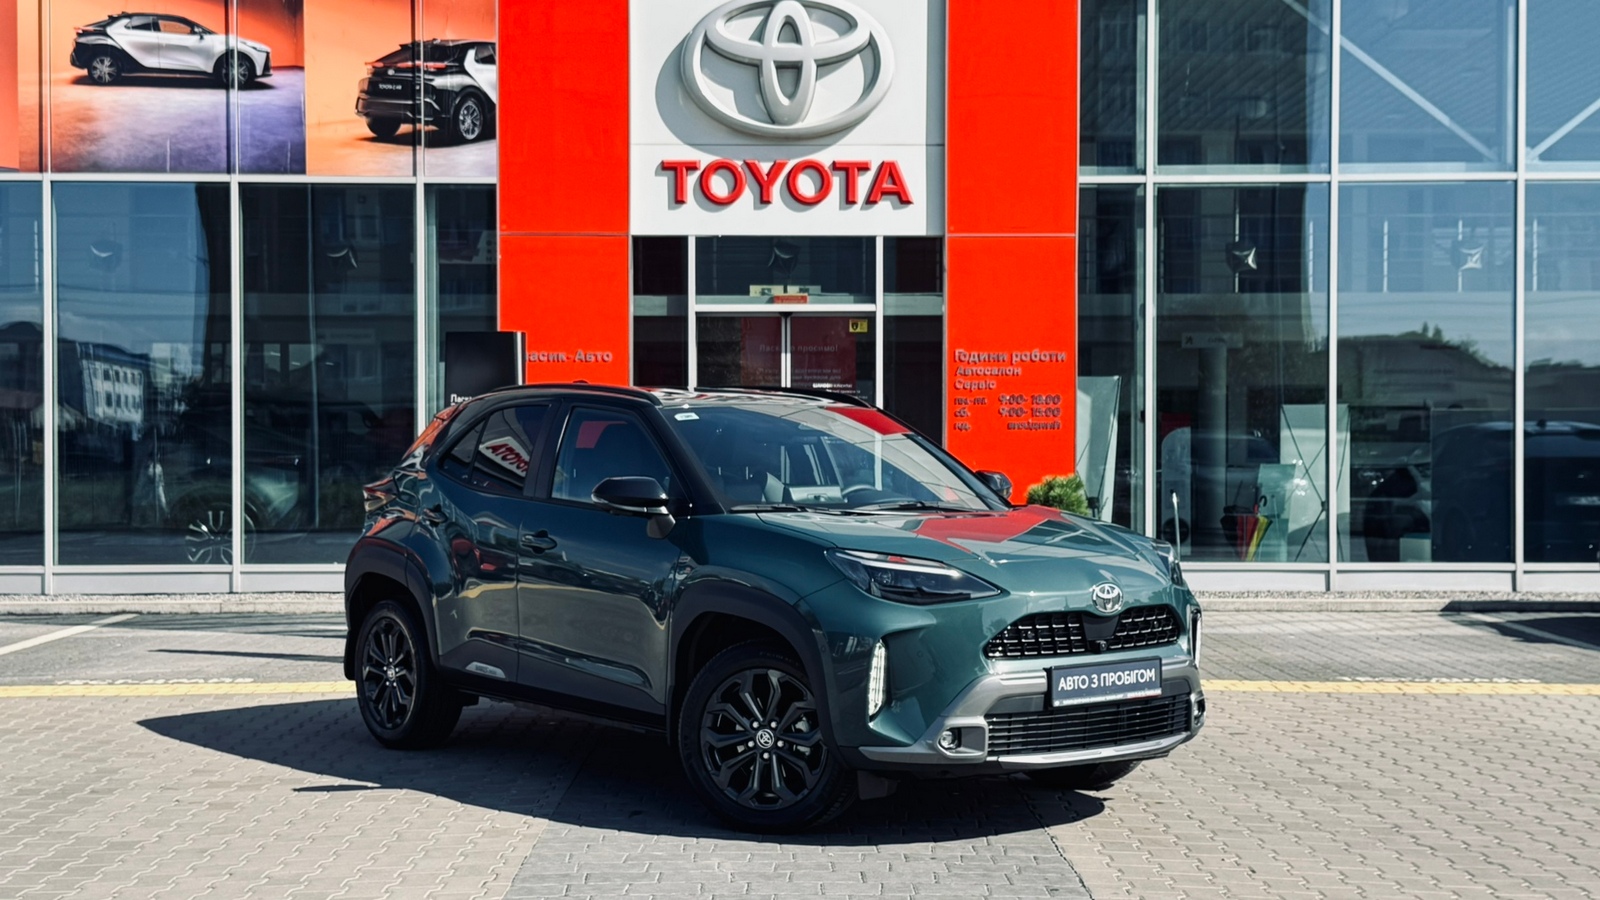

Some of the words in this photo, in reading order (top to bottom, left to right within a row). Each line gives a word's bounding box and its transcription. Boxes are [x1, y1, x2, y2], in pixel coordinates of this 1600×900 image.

[661, 158, 914, 206] TOYOTA
[954, 349, 1007, 364] Години
[1011, 348, 1066, 365] роботи
[955, 366, 1021, 376] Автосалон
[1058, 675, 1089, 691] АВТО
[1100, 668, 1156, 687] ПРОБІГОМ
